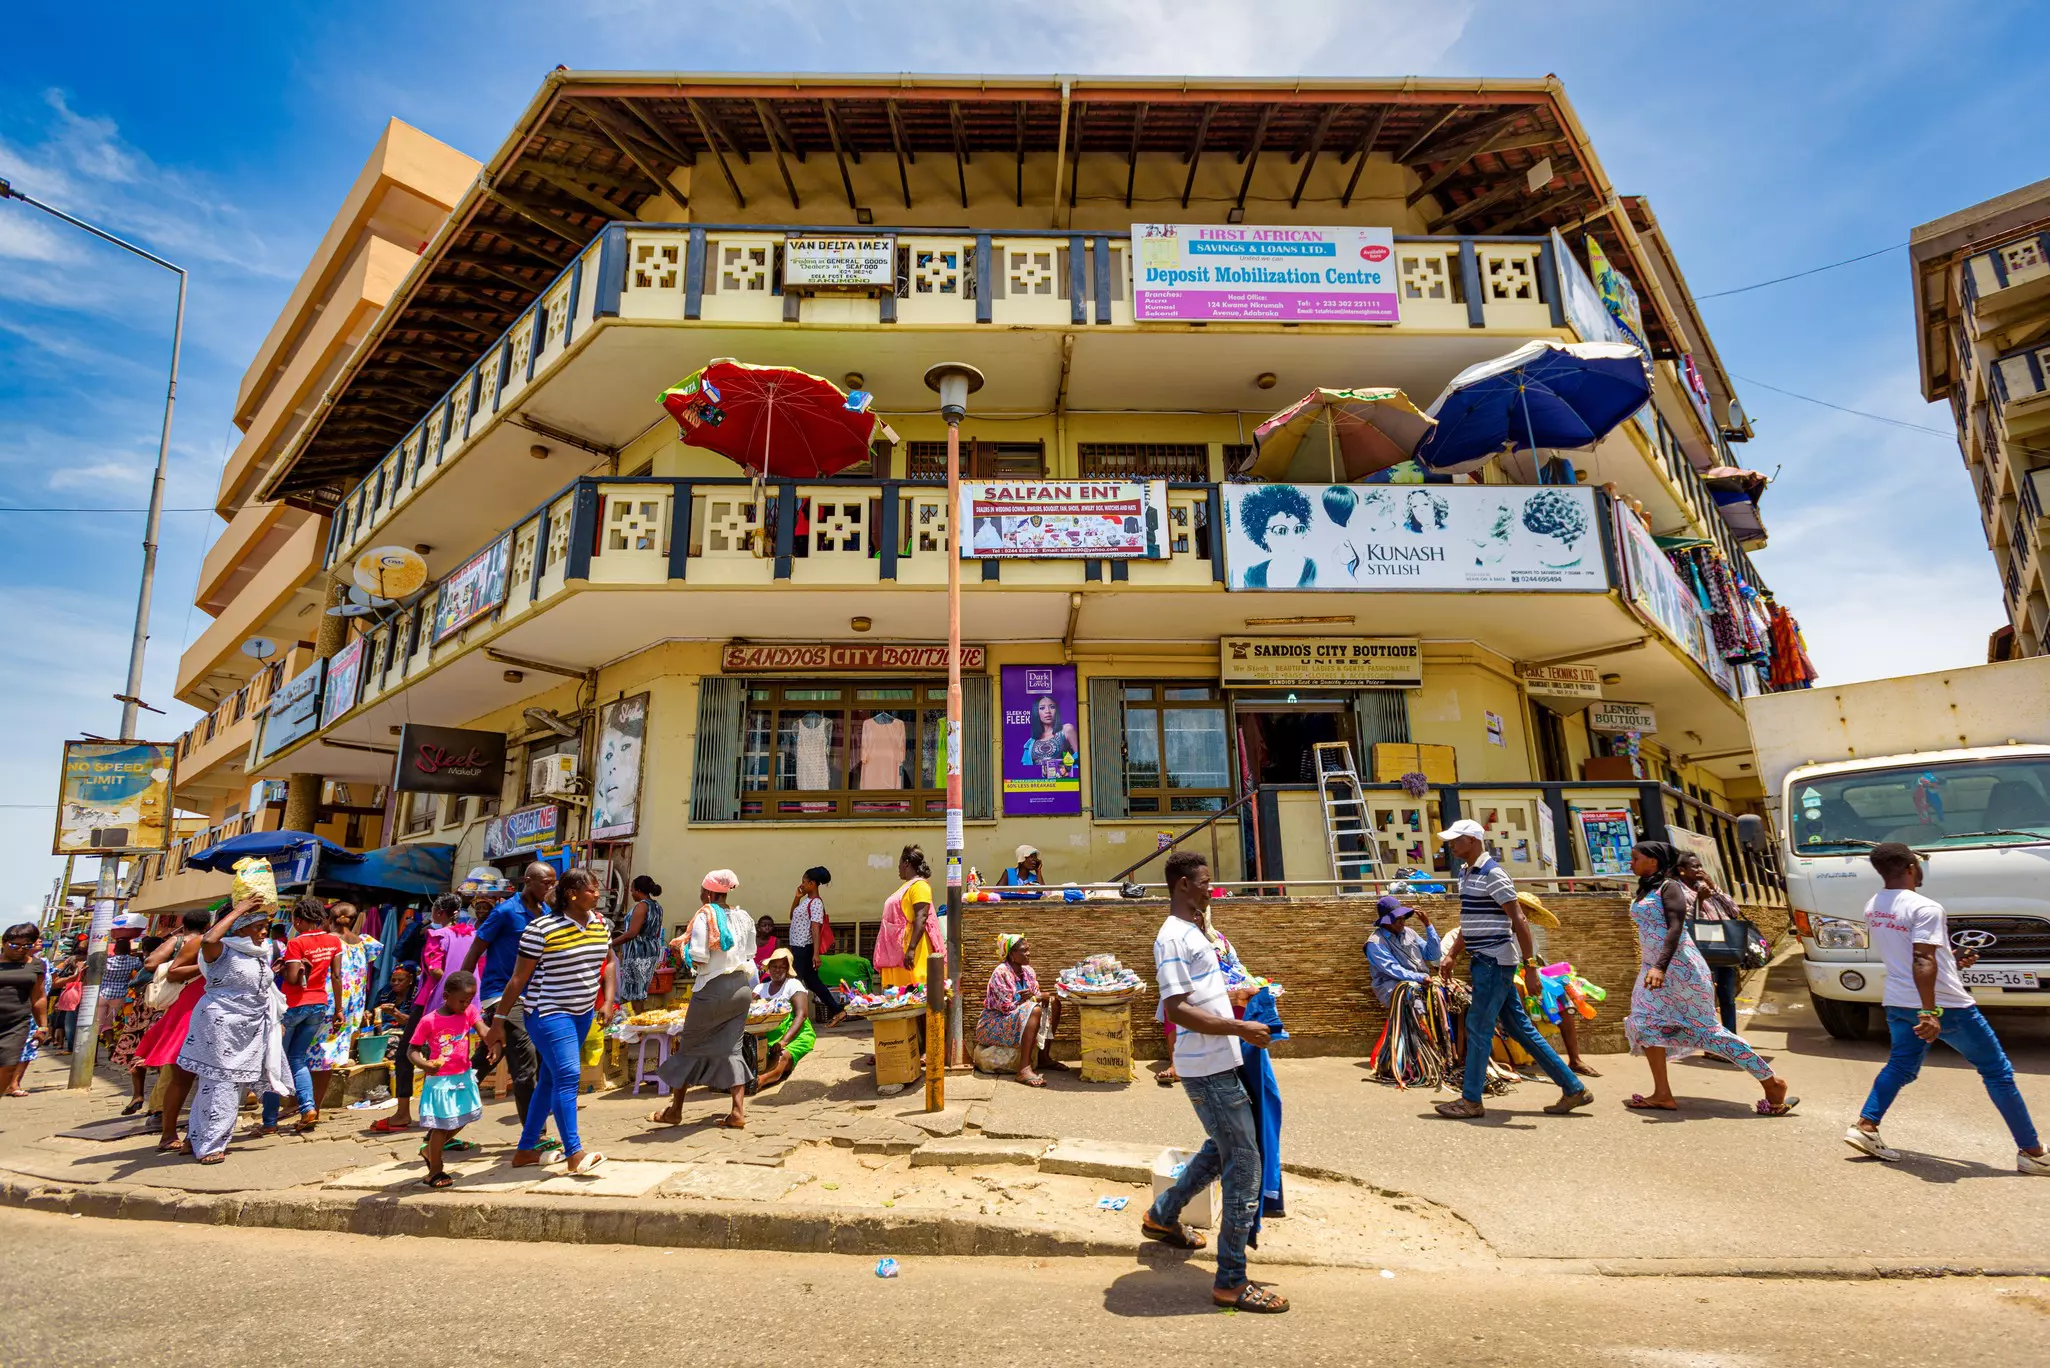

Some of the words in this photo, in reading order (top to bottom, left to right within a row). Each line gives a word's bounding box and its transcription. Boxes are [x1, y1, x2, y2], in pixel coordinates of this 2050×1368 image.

[1200, 229, 1248, 241] FIRST
[1253, 230, 1323, 242] AFRICAN
[790, 241, 815, 250] VAN
[818, 241, 855, 250] DELTA
[859, 241, 889, 250] IMEX
[1197, 244, 1245, 253] SAVINGS
[1249, 244, 1257, 253] &
[1302, 246, 1327, 254] LTD.
[1146, 266, 1210, 286] Deposit
[1215, 266, 1320, 284] Mobilization
[1326, 268, 1381, 284] Centre
[984, 486, 1072, 501] SALFAN
[1080, 486, 1121, 500] ENT
[1367, 544, 1445, 562] KUNASH
[1367, 564, 1421, 576] STYLISH
[1254, 644, 1311, 657] SANDIO'S
[1317, 646, 1348, 657] CITY
[1353, 646, 1417, 657] BOUTIQUE
[833, 649, 877, 665] CITY
[1029, 673, 1049, 681] Dark
[1526, 668, 1545, 678] CAKE
[1548, 667, 1579, 681] TEKNIKS
[1581, 668, 1597, 682] LTD.
[1029, 681, 1051, 689] Lovely
[1604, 705, 1640, 715] LENEC
[1006, 716, 1031, 725] FLEEK
[1594, 714, 1652, 726] BOUTIQUE
[415, 744, 491, 774] Sleek
[67, 762, 90, 772] NO
[94, 762, 144, 772] SPEED
[85, 776, 126, 785] LIMIT
[504, 806, 558, 853] SPORTNET
[1096, 1057, 1124, 1066] FRANCIS
